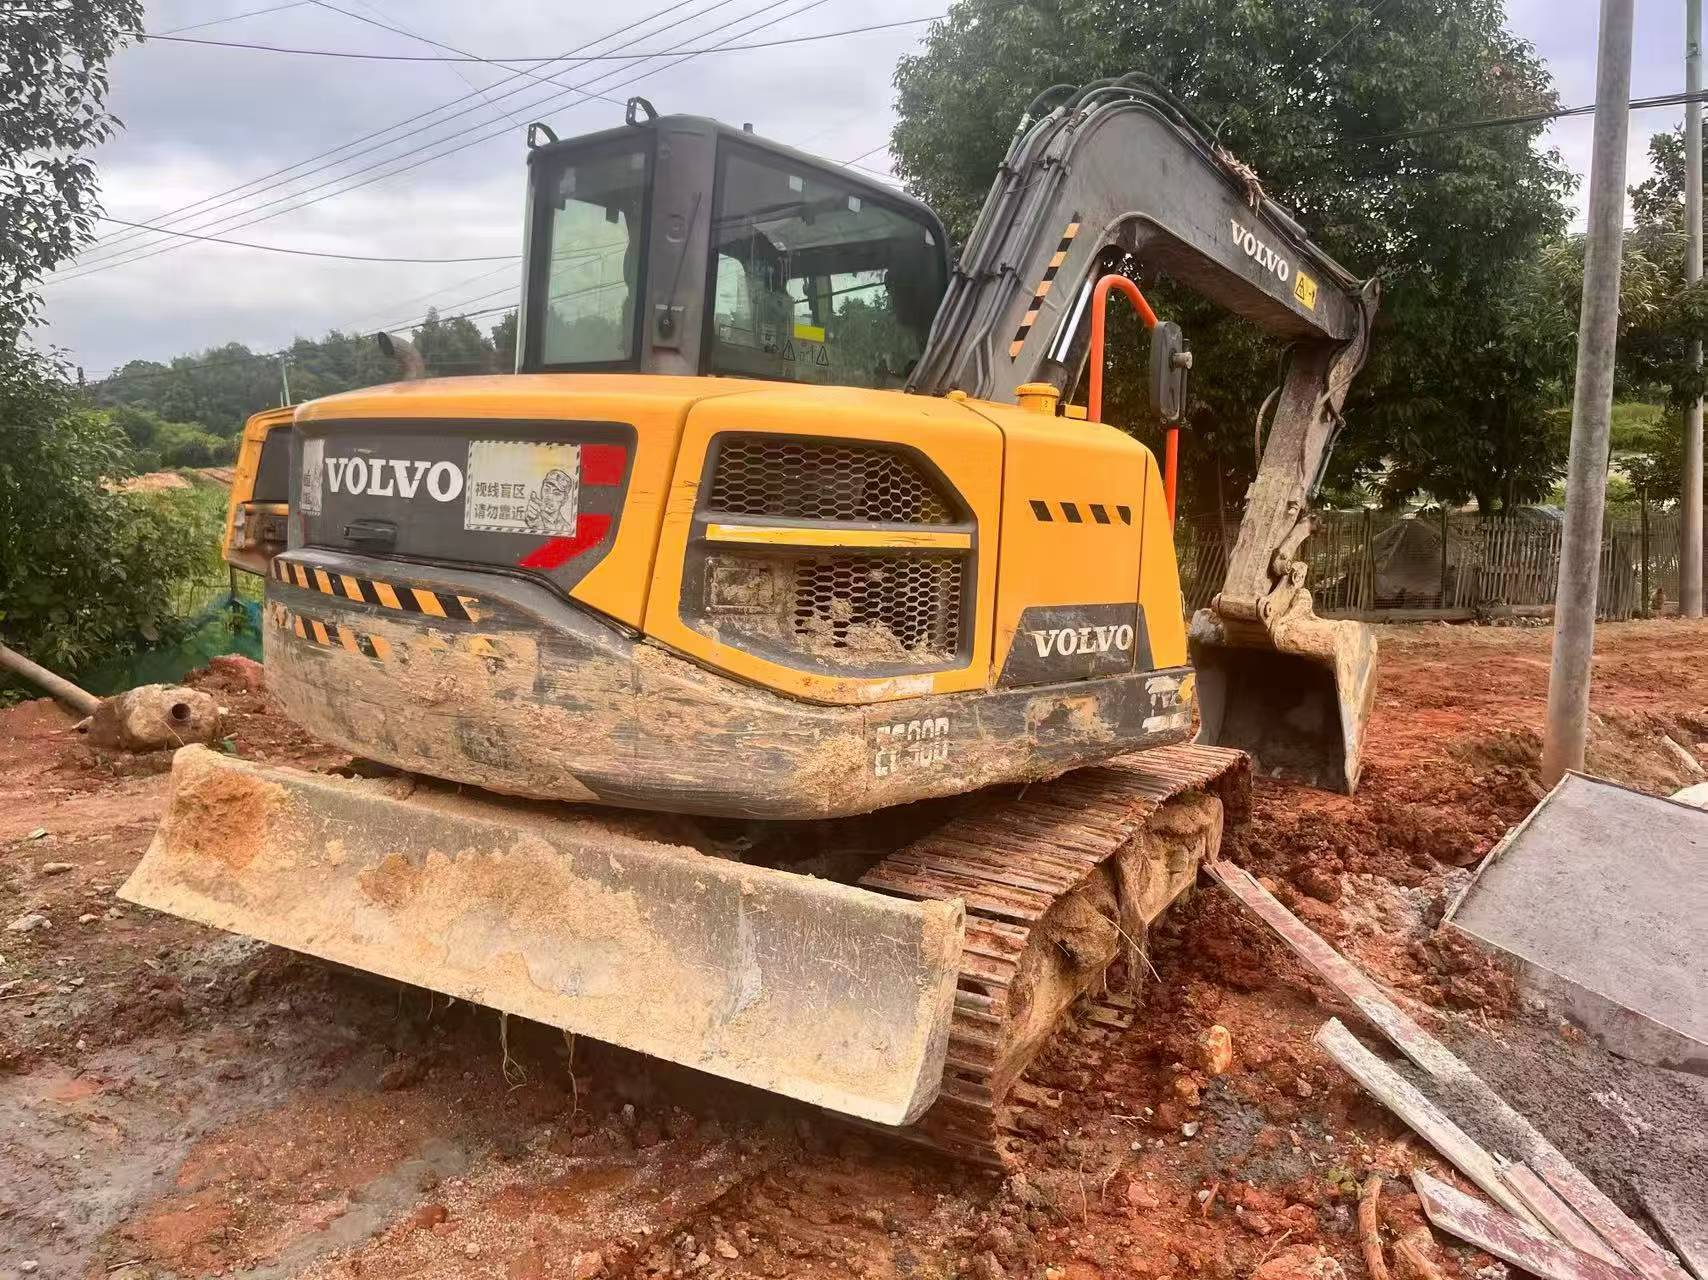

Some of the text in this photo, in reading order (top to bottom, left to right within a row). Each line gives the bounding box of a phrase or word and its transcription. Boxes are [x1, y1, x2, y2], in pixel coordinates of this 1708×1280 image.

[1230, 218, 1289, 282] VOLVO
[325, 456, 463, 502] VOLVO
[475, 481, 526, 499] 视线盲区
[474, 503, 525, 520] 请勿靠近
[1032, 624, 1134, 658] VOLVO
